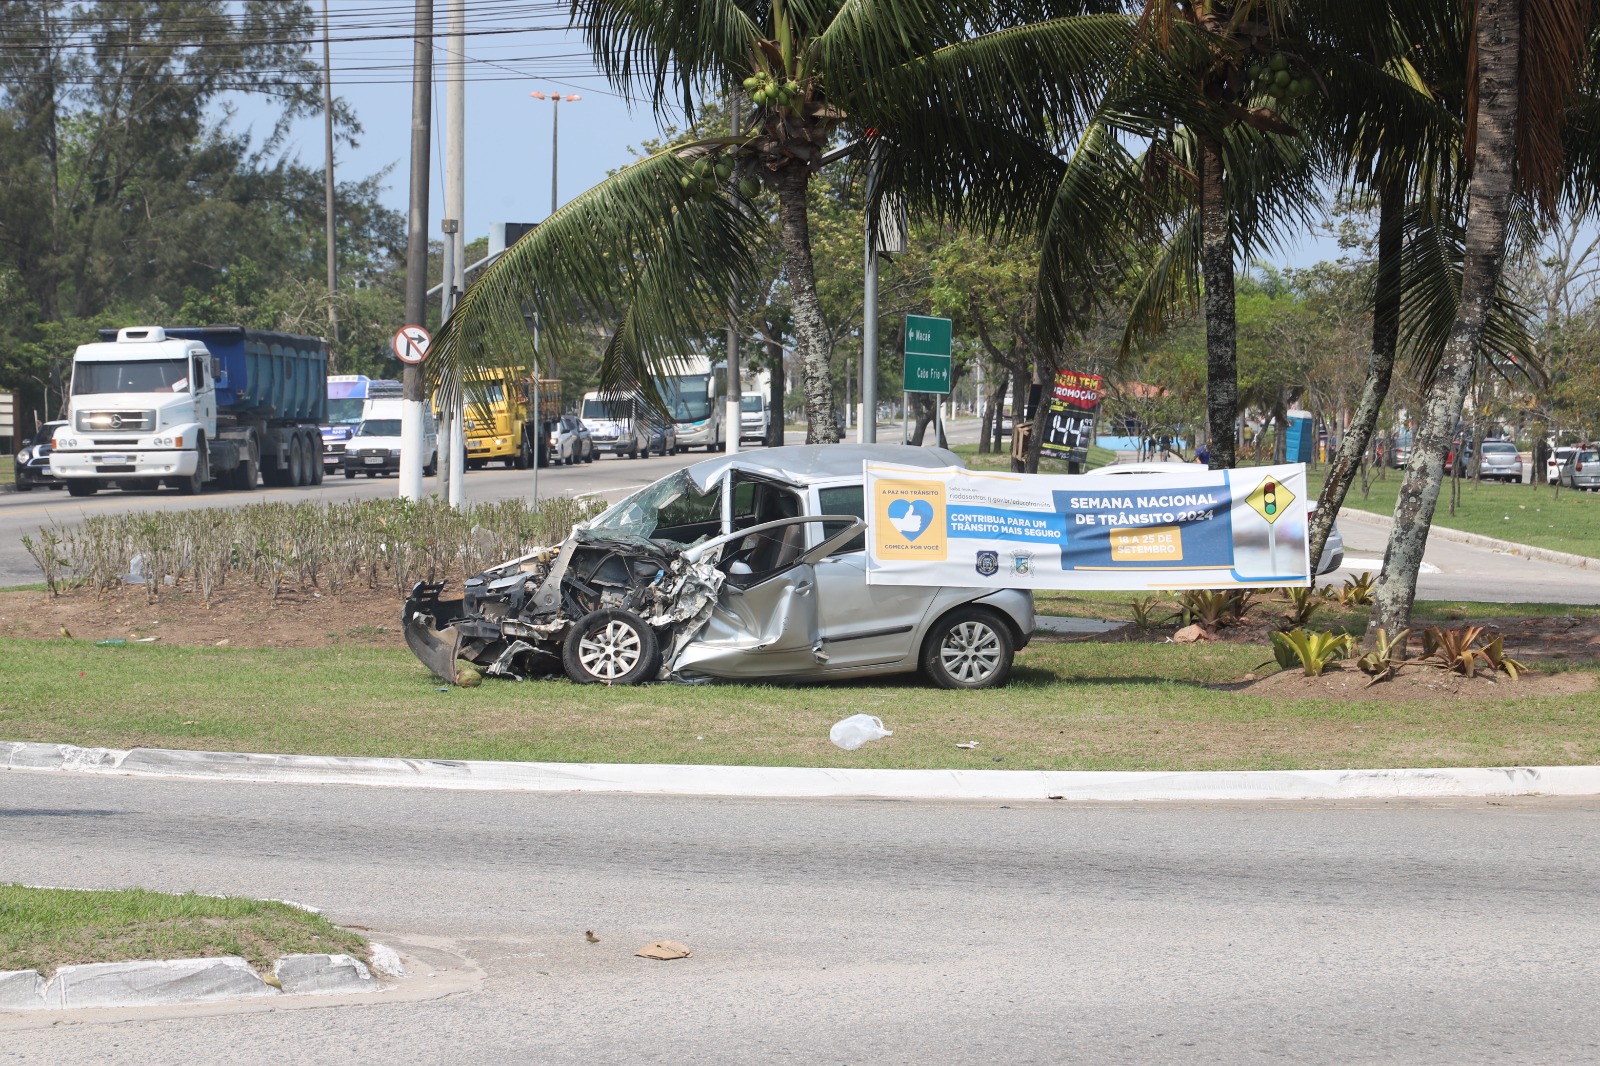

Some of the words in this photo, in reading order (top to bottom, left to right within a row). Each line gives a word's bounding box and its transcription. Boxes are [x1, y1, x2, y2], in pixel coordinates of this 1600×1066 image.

[915, 330, 931, 342] Macaé
[916, 367, 929, 379] Cabo
[930, 368, 941, 380] Frio
[1079, 377, 1099, 390] TEM
[1070, 497, 1134, 509] SEMANA
[1137, 493, 1218, 508] NACIONAL
[950, 513, 1006, 525] CONTRIBUA
[1007, 517, 1031, 528] PARA
[1032, 520, 1047, 529] UM
[1075, 513, 1096, 525] DE
[1098, 511, 1175, 526] TRÂNSITO
[1176, 509, 1214, 522] 2024
[950, 521, 1000, 533] TRÂNSITO
[1001, 525, 1023, 535] MAIS
[1024, 528, 1062, 539] SEGURO
[1118, 535, 1129, 544] 18
[1131, 535, 1140, 544] A
[1142, 535, 1155, 544] 25
[1157, 534, 1173, 543] DE
[1117, 544, 1176, 555] SETEMBRO
